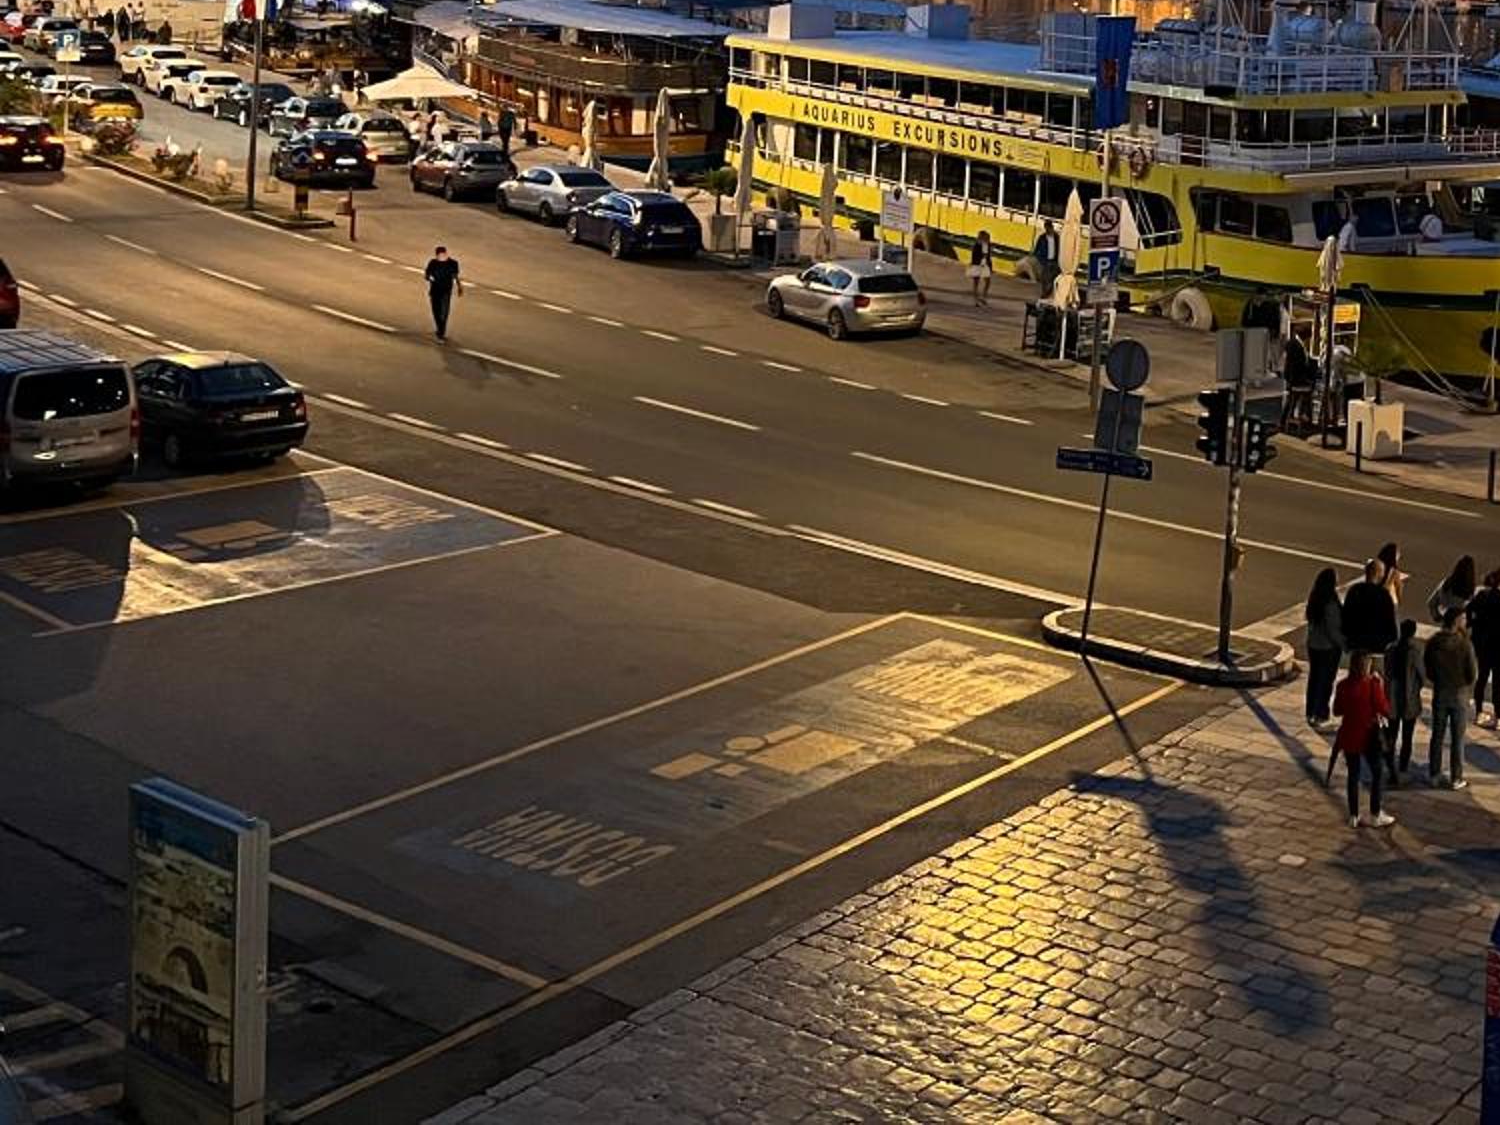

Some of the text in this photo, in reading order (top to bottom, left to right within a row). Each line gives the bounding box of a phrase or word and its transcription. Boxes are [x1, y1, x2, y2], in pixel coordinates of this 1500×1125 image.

[63, 34, 74, 47] P
[803, 103, 875, 131] AQUARIUS
[892, 121, 1004, 157] EXCURSIONS
[1097, 256, 1111, 279] P
